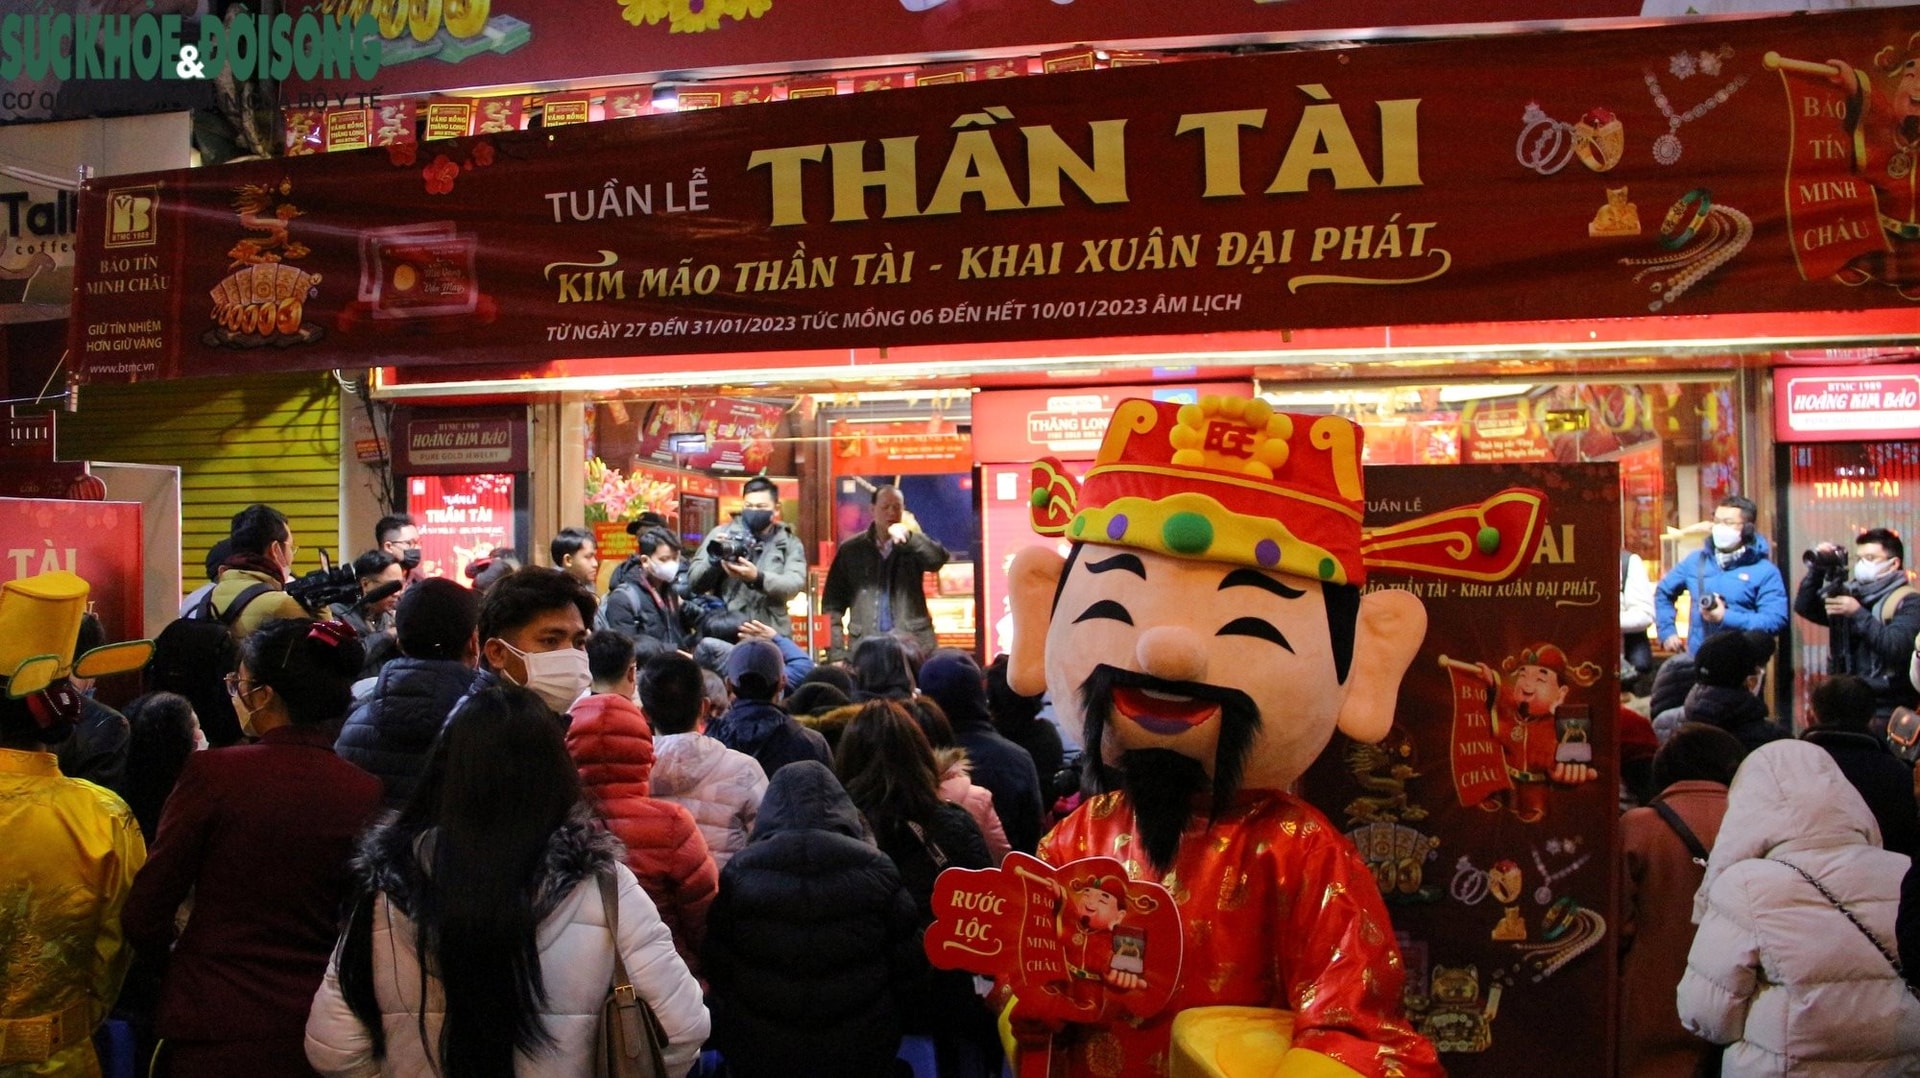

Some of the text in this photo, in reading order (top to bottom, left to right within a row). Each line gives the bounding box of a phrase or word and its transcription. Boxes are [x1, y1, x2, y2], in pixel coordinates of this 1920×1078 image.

[747, 83, 1425, 228] THẦN TÀI
[1810, 136, 1847, 160] TÍN
[545, 167, 710, 225] TUẦN LỄ
[1799, 180, 1858, 206] MINH
[1803, 219, 1872, 252] CHÂU
[133, 253, 159, 271] TÍN
[544, 250, 627, 304] KIM
[638, 258, 720, 299] MÃO
[734, 241, 838, 294] THẦN
[850, 243, 915, 287] TÀI
[957, 241, 1063, 281] KHAI
[1075, 226, 1202, 274] XUÂN
[1215, 228, 1296, 275] ĐẠI
[1300, 213, 1452, 284] PHÁT
[87, 273, 170, 295] MINH CHÂU
[546, 291, 1243, 342] TỪ NGÀY 27 ĐẾN 31/01/2023 TỨC MỒNG 06 ĐẾN HẾT 10/01/2023 ÂM LỊCH
[134, 337, 163, 350] VÀNG
[89, 362, 156, 374] www.btmc.vn
[1850, 392, 1881, 409] KIM
[1032, 416, 1110, 432] THĂNG LON
[456, 431, 479, 446] KIM
[1428, 578, 1448, 598] TÀI
[1535, 580, 1558, 601] ĐẠI
[1459, 741, 1494, 757] MINH
[1461, 766, 1500, 788] CHÂU
[951, 888, 1007, 915] RƯỚC
[955, 916, 992, 944] LỘC
[1026, 935, 1057, 951] MINH
[1026, 957, 1060, 973] CHÂU
